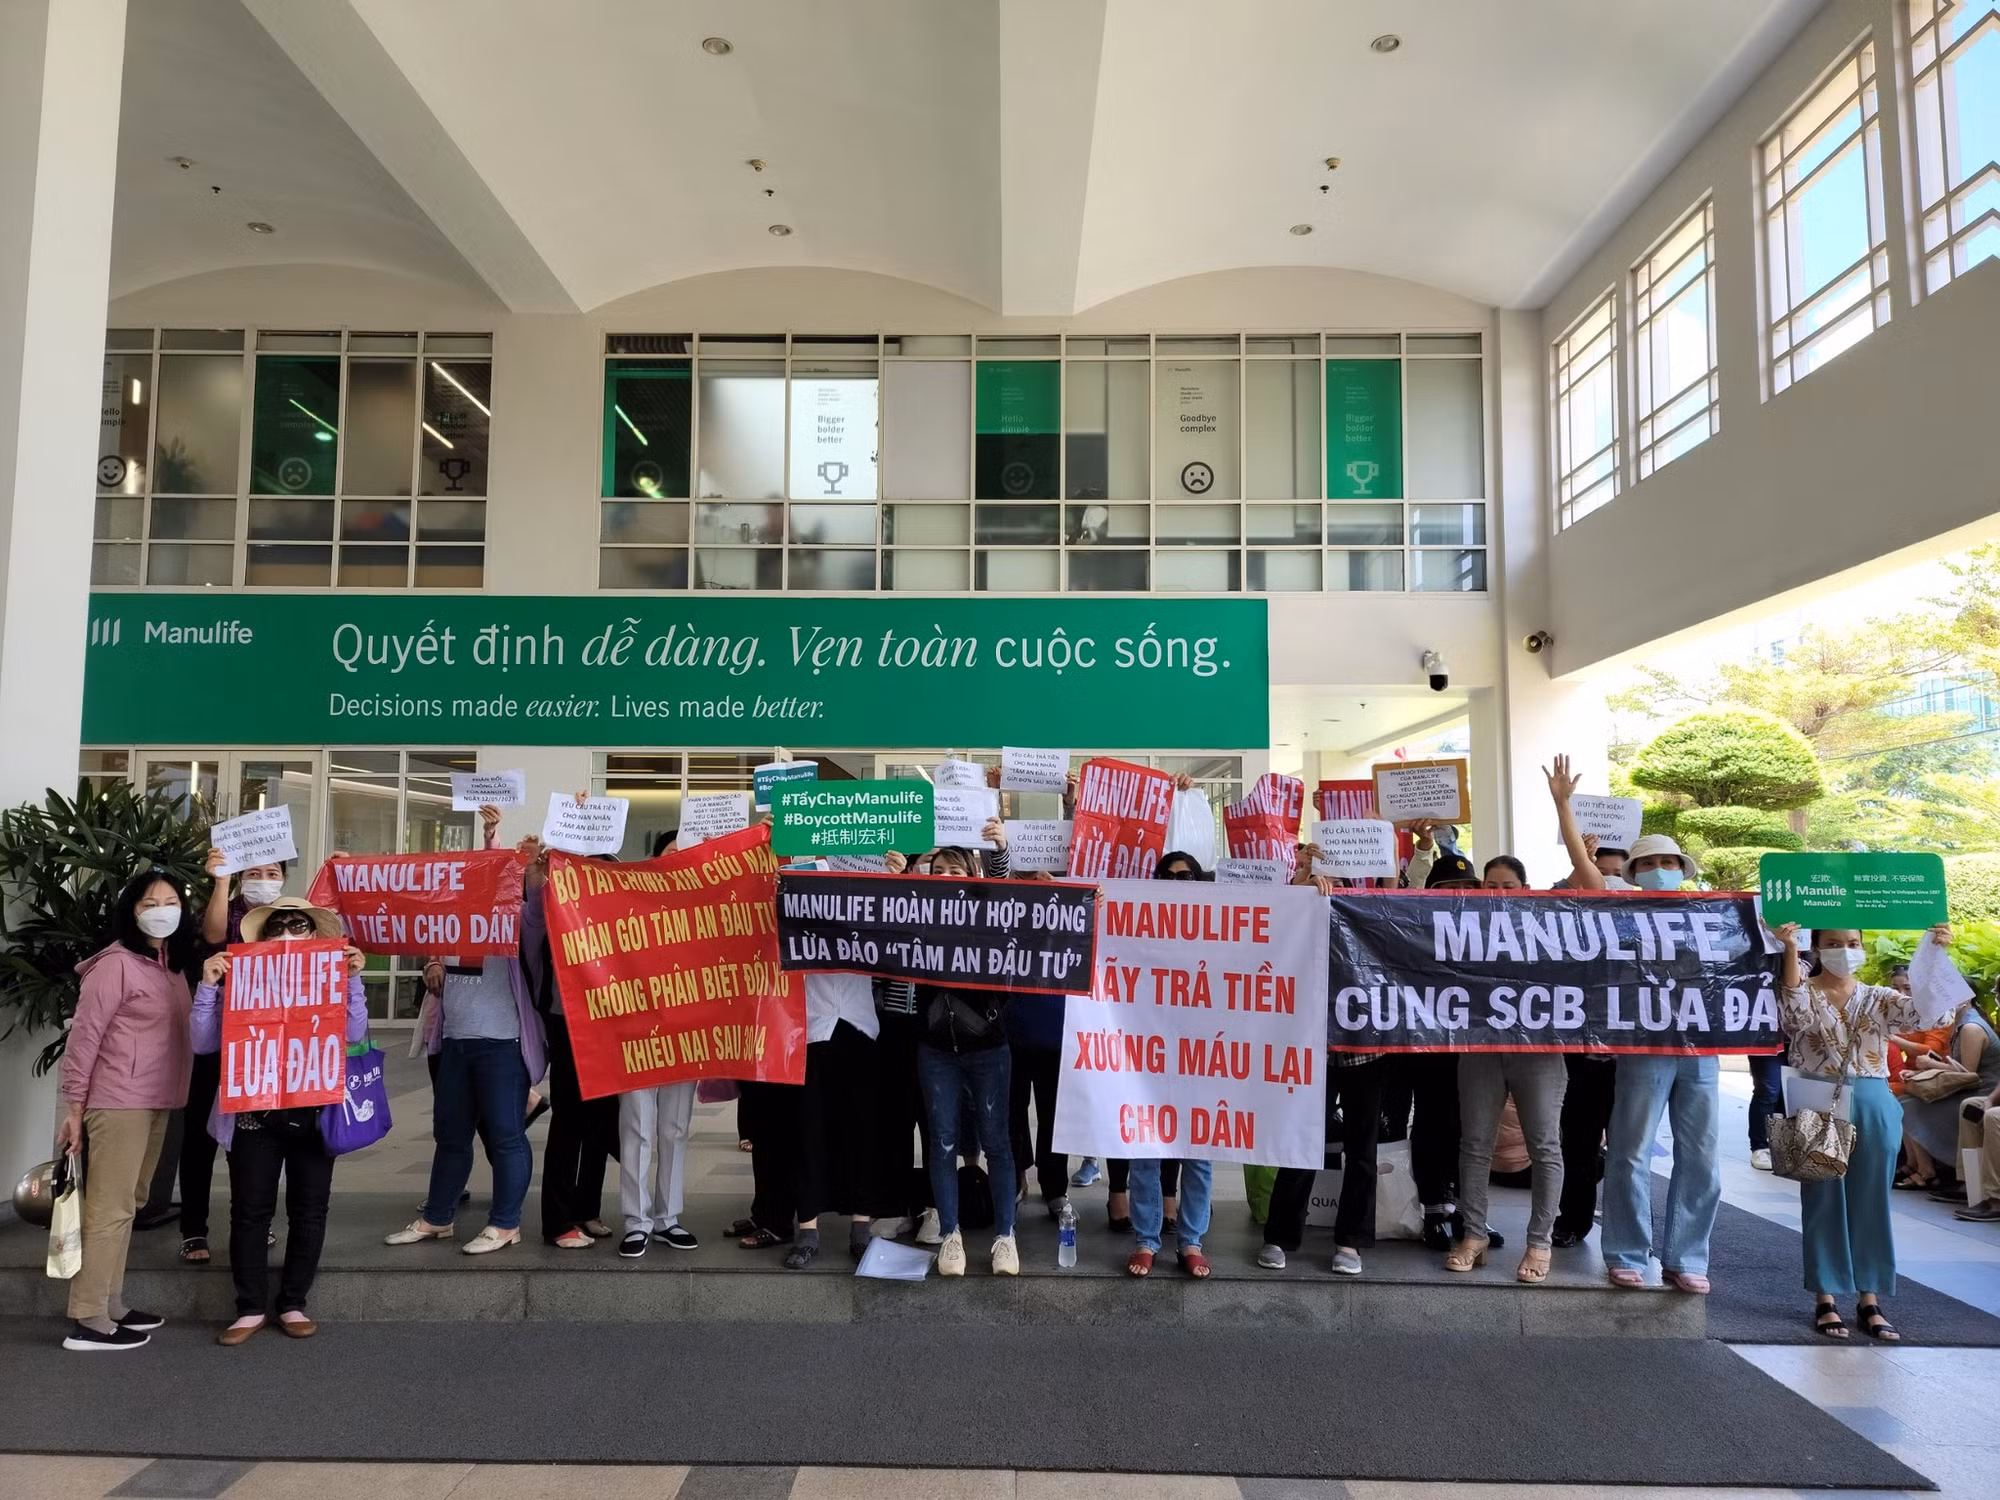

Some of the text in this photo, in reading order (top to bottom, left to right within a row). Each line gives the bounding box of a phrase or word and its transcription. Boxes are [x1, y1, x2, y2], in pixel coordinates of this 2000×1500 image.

[102, 418, 125, 427] imple
[818, 416, 844, 424] Bigger
[1180, 414, 1216, 423] Goodbye
[1180, 425, 1216, 433] complex
[1346, 414, 1374, 422] Bigger
[1346, 434, 1371, 442] better
[144, 620, 253, 644] Manulife
[332, 617, 1231, 677] Quyết định dễ dàng. Vẹn toàn cuộc sống.
[329, 692, 824, 719] Decisions made easier. Lives made better.
[782, 791, 924, 808] #TẩyChayManulife
[1081, 765, 1170, 824] MANULIFE
[1324, 790, 1374, 820] MANU
[784, 811, 922, 827] #BoycottManulife
[811, 828, 895, 846] #抵制宏利
[1071, 826, 1111, 878] LỪA
[334, 862, 465, 892] MANULIFE
[553, 858, 580, 908] BỘ
[666, 866, 702, 892] XIN
[702, 851, 743, 885] CỨU
[742, 843, 778, 882] NẠN
[1796, 886, 1846, 896] Manulie
[357, 902, 406, 944] TIỀN
[414, 915, 461, 944] CHO
[470, 907, 515, 944] DÂN
[561, 917, 614, 967] NHẬN
[616, 908, 649, 953] GÓI
[650, 904, 691, 946] TÂM
[694, 906, 718, 941] AN
[720, 890, 753, 937] ĐẦU
[784, 889, 1086, 933] MANULIFE HOÀN HỦY HỢP ĐỒNG
[1106, 901, 1270, 944] MANULIFE
[788, 930, 1082, 980] LỪA ĐẢO “TÂM AN ĐẦU TƯ”
[1432, 911, 1731, 961] MANULIFE
[230, 950, 344, 1011] MANULIFE
[585, 974, 648, 1021] KHÔNG
[648, 963, 698, 1010] PHÂN
[701, 956, 740, 1006] BIỆT
[743, 950, 769, 996] ĐỐI
[1151, 960, 1212, 1008] TRẢ
[1223, 961, 1295, 1014] TIỀN
[1334, 970, 1779, 1032] CÙNG SCB LỪA ĐẢ
[227, 1015, 340, 1098] LỪA ĐẢO
[621, 1025, 675, 1074] KHIẾU
[678, 1028, 710, 1070] NẠI
[712, 1024, 741, 1061] SAU
[1074, 1028, 1312, 1094] XƯƠNG MÁU LẠI
[1119, 1100, 1255, 1150] CHO DÂN
